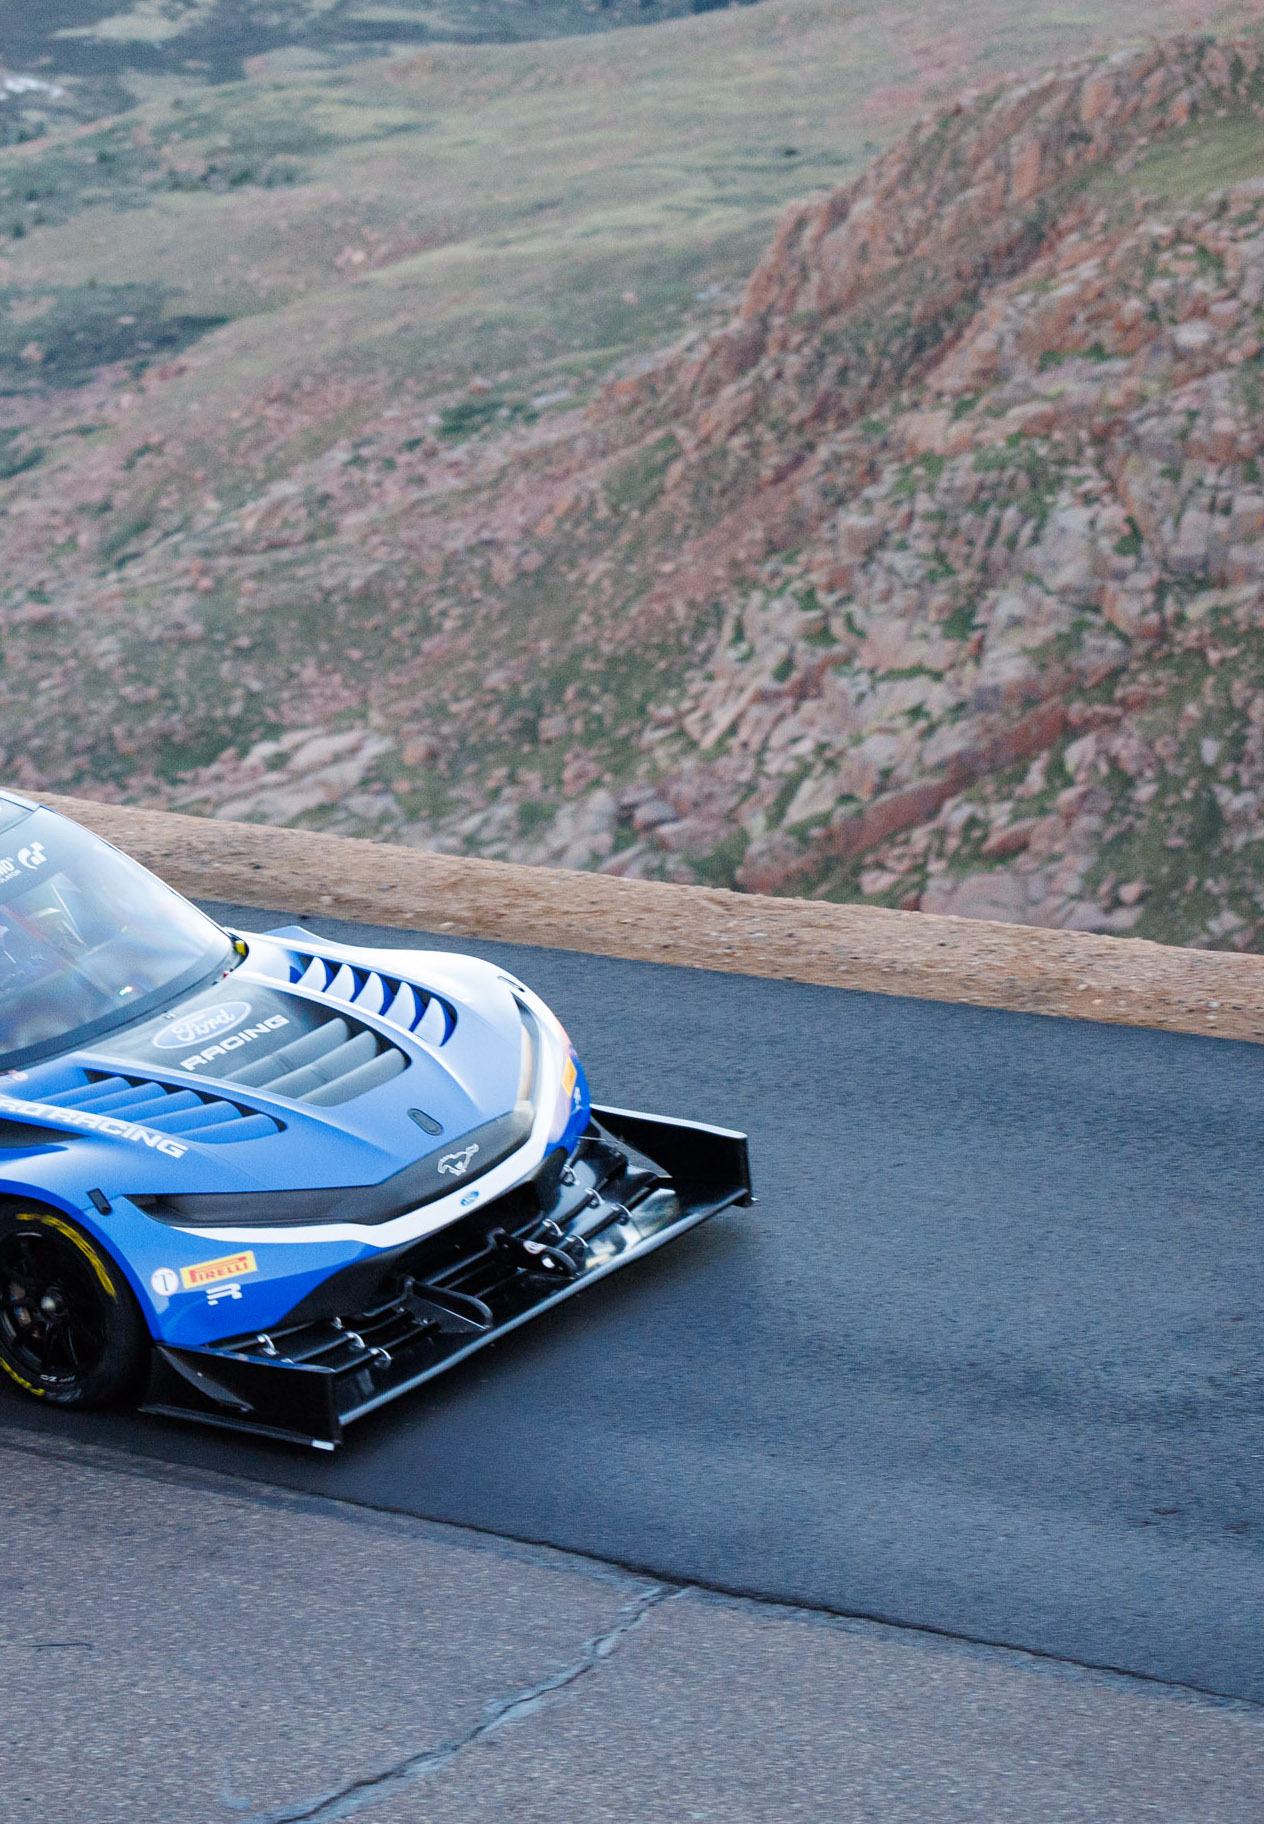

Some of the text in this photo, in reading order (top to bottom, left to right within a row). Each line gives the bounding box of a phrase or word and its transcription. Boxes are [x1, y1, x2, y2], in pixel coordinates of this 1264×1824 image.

[171, 1008, 236, 1043] Ford
[46, 1106, 189, 1159] RACING
[188, 1255, 249, 1284] PIRELLI
